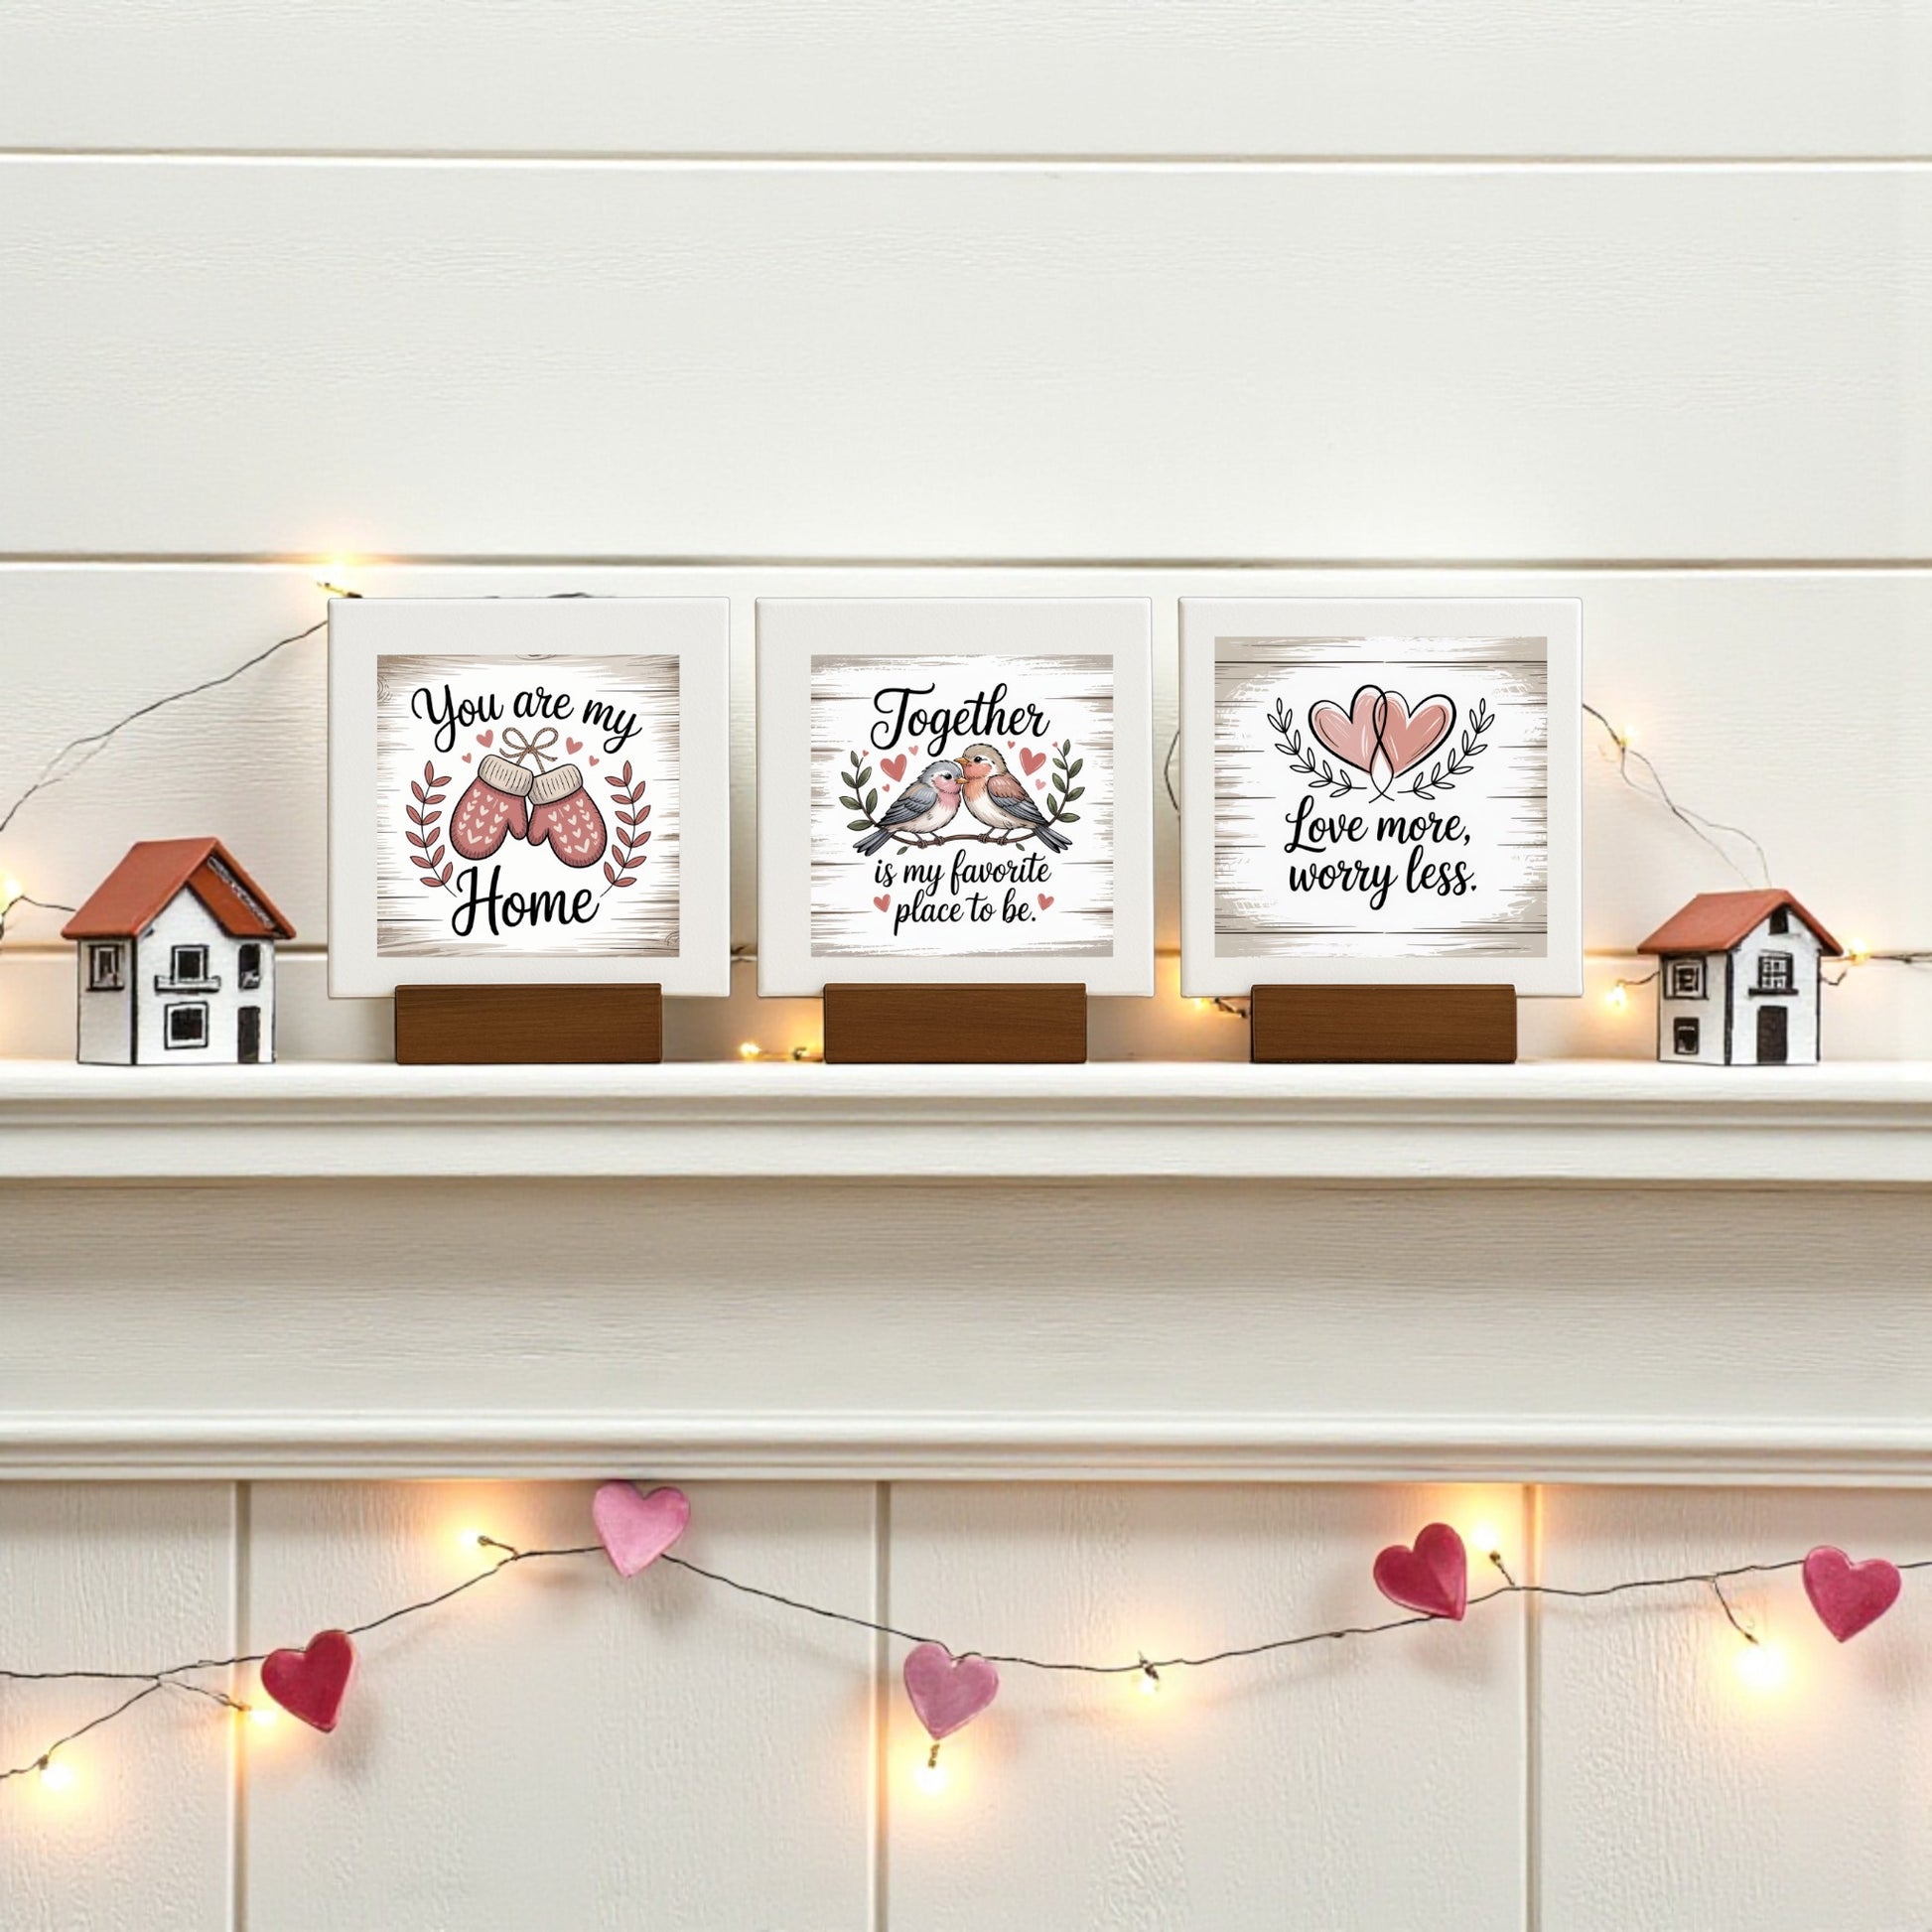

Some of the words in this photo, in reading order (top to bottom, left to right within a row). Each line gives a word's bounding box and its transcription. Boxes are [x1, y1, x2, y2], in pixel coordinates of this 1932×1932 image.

[411, 684, 504, 754] You
[513, 686, 575, 720] are
[582, 699, 643, 755] my
[870, 683, 1050, 758] Together
[1284, 794, 1369, 854] Love
[1376, 811, 1471, 846] more,
[451, 865, 600, 936] Home
[874, 859, 897, 888] is
[902, 864, 945, 897] my
[950, 849, 1052, 896] favorite
[1289, 860, 1399, 910] worry
[1406, 844, 1477, 897] less.
[894, 889, 964, 936] place
[966, 892, 996, 922] to
[1002, 888, 1036, 923] be.
